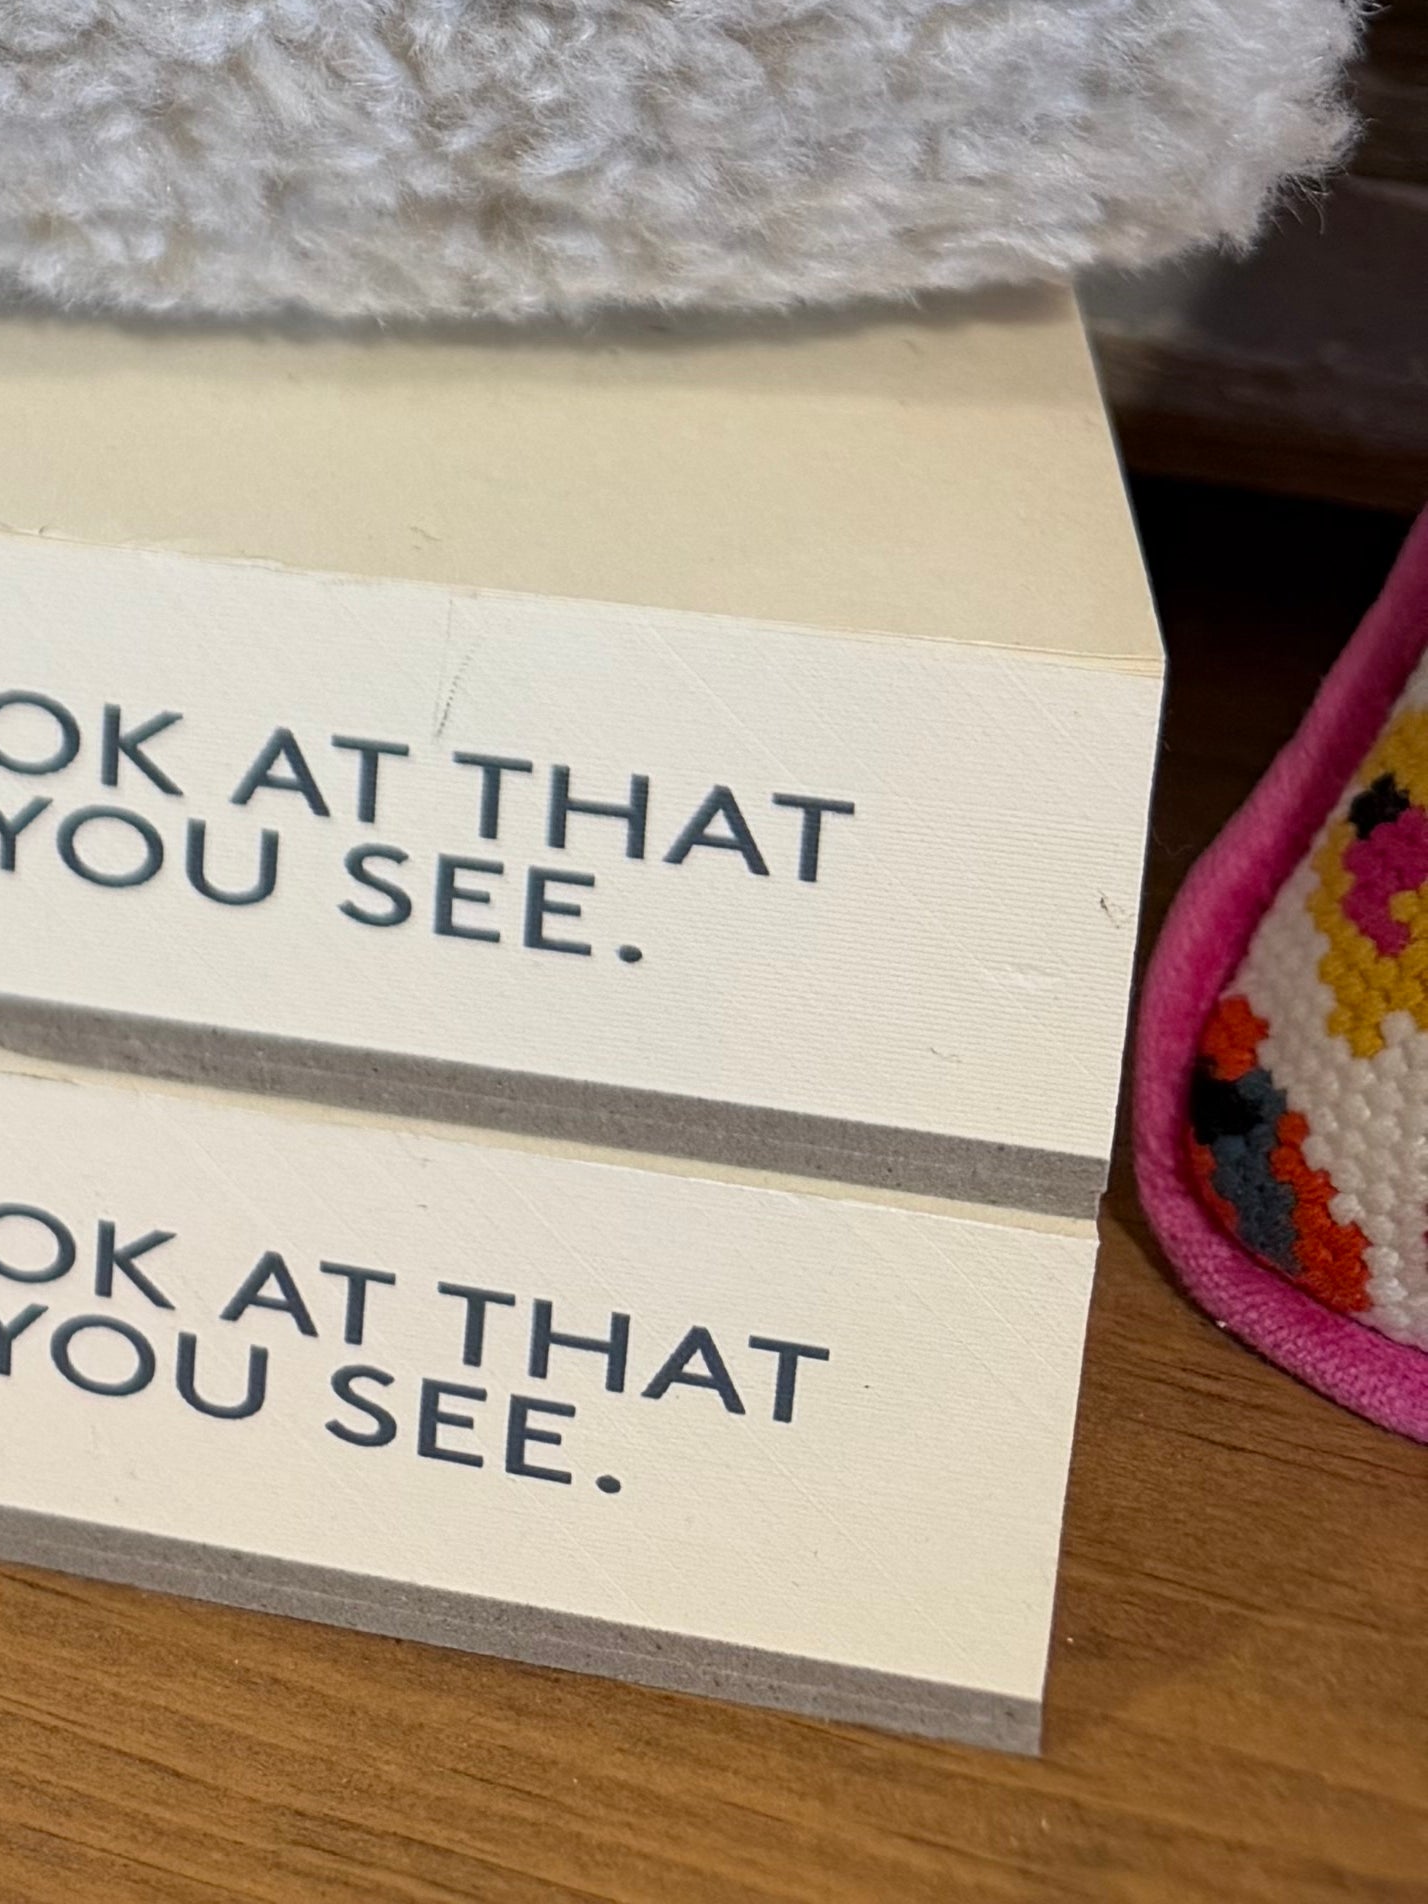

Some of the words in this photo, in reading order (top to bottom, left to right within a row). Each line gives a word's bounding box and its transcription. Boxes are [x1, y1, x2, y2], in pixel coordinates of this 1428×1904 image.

[231, 729, 410, 824] AT
[453, 752, 855, 883] THAT
[339, 845, 643, 964] SEE.
[220, 1251, 396, 1346] AT
[437, 1281, 830, 1424] THAT
[325, 1365, 622, 1494] SEE.
